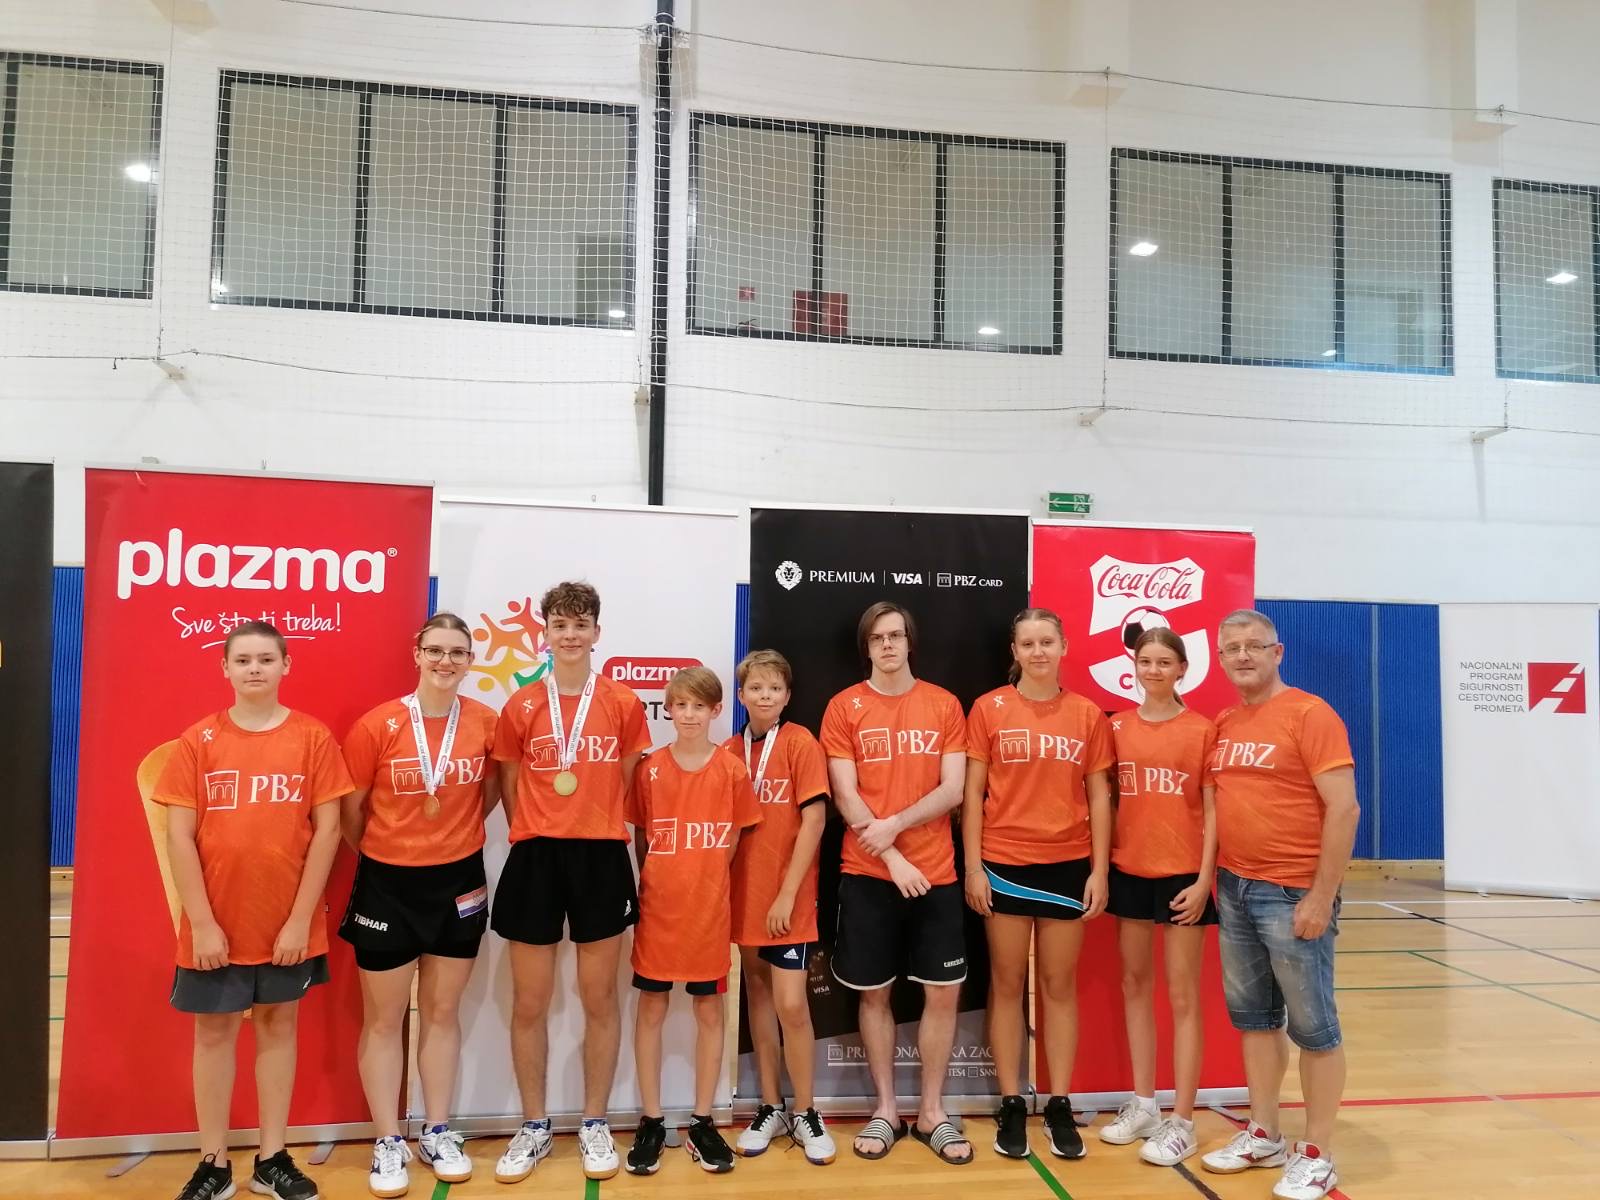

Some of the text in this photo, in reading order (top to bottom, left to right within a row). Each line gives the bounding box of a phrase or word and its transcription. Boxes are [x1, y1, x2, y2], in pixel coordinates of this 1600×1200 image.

[809, 570, 1003, 587] PREMIUM VISA PBZ CARD
[172, 607, 215, 638] Sve
[282, 602, 341, 632] treba!
[612, 661, 688, 682] plazm
[1460, 661, 1523, 670] NACIONALNI
[1459, 682, 1523, 691] SIGURNOSTI
[1470, 672, 1523, 681] PROGRAM
[1458, 693, 1524, 702] CESTOVNOG
[1474, 704, 1525, 713] PROMETA
[896, 729, 940, 756] PBZ
[1036, 733, 1085, 765] PBZ
[1228, 742, 1277, 769] PBZ
[248, 774, 306, 804] PBZ
[1143, 767, 1190, 795] PBZ
[684, 822, 733, 849] PBZ
[354, 913, 389, 932] TIBHAR
